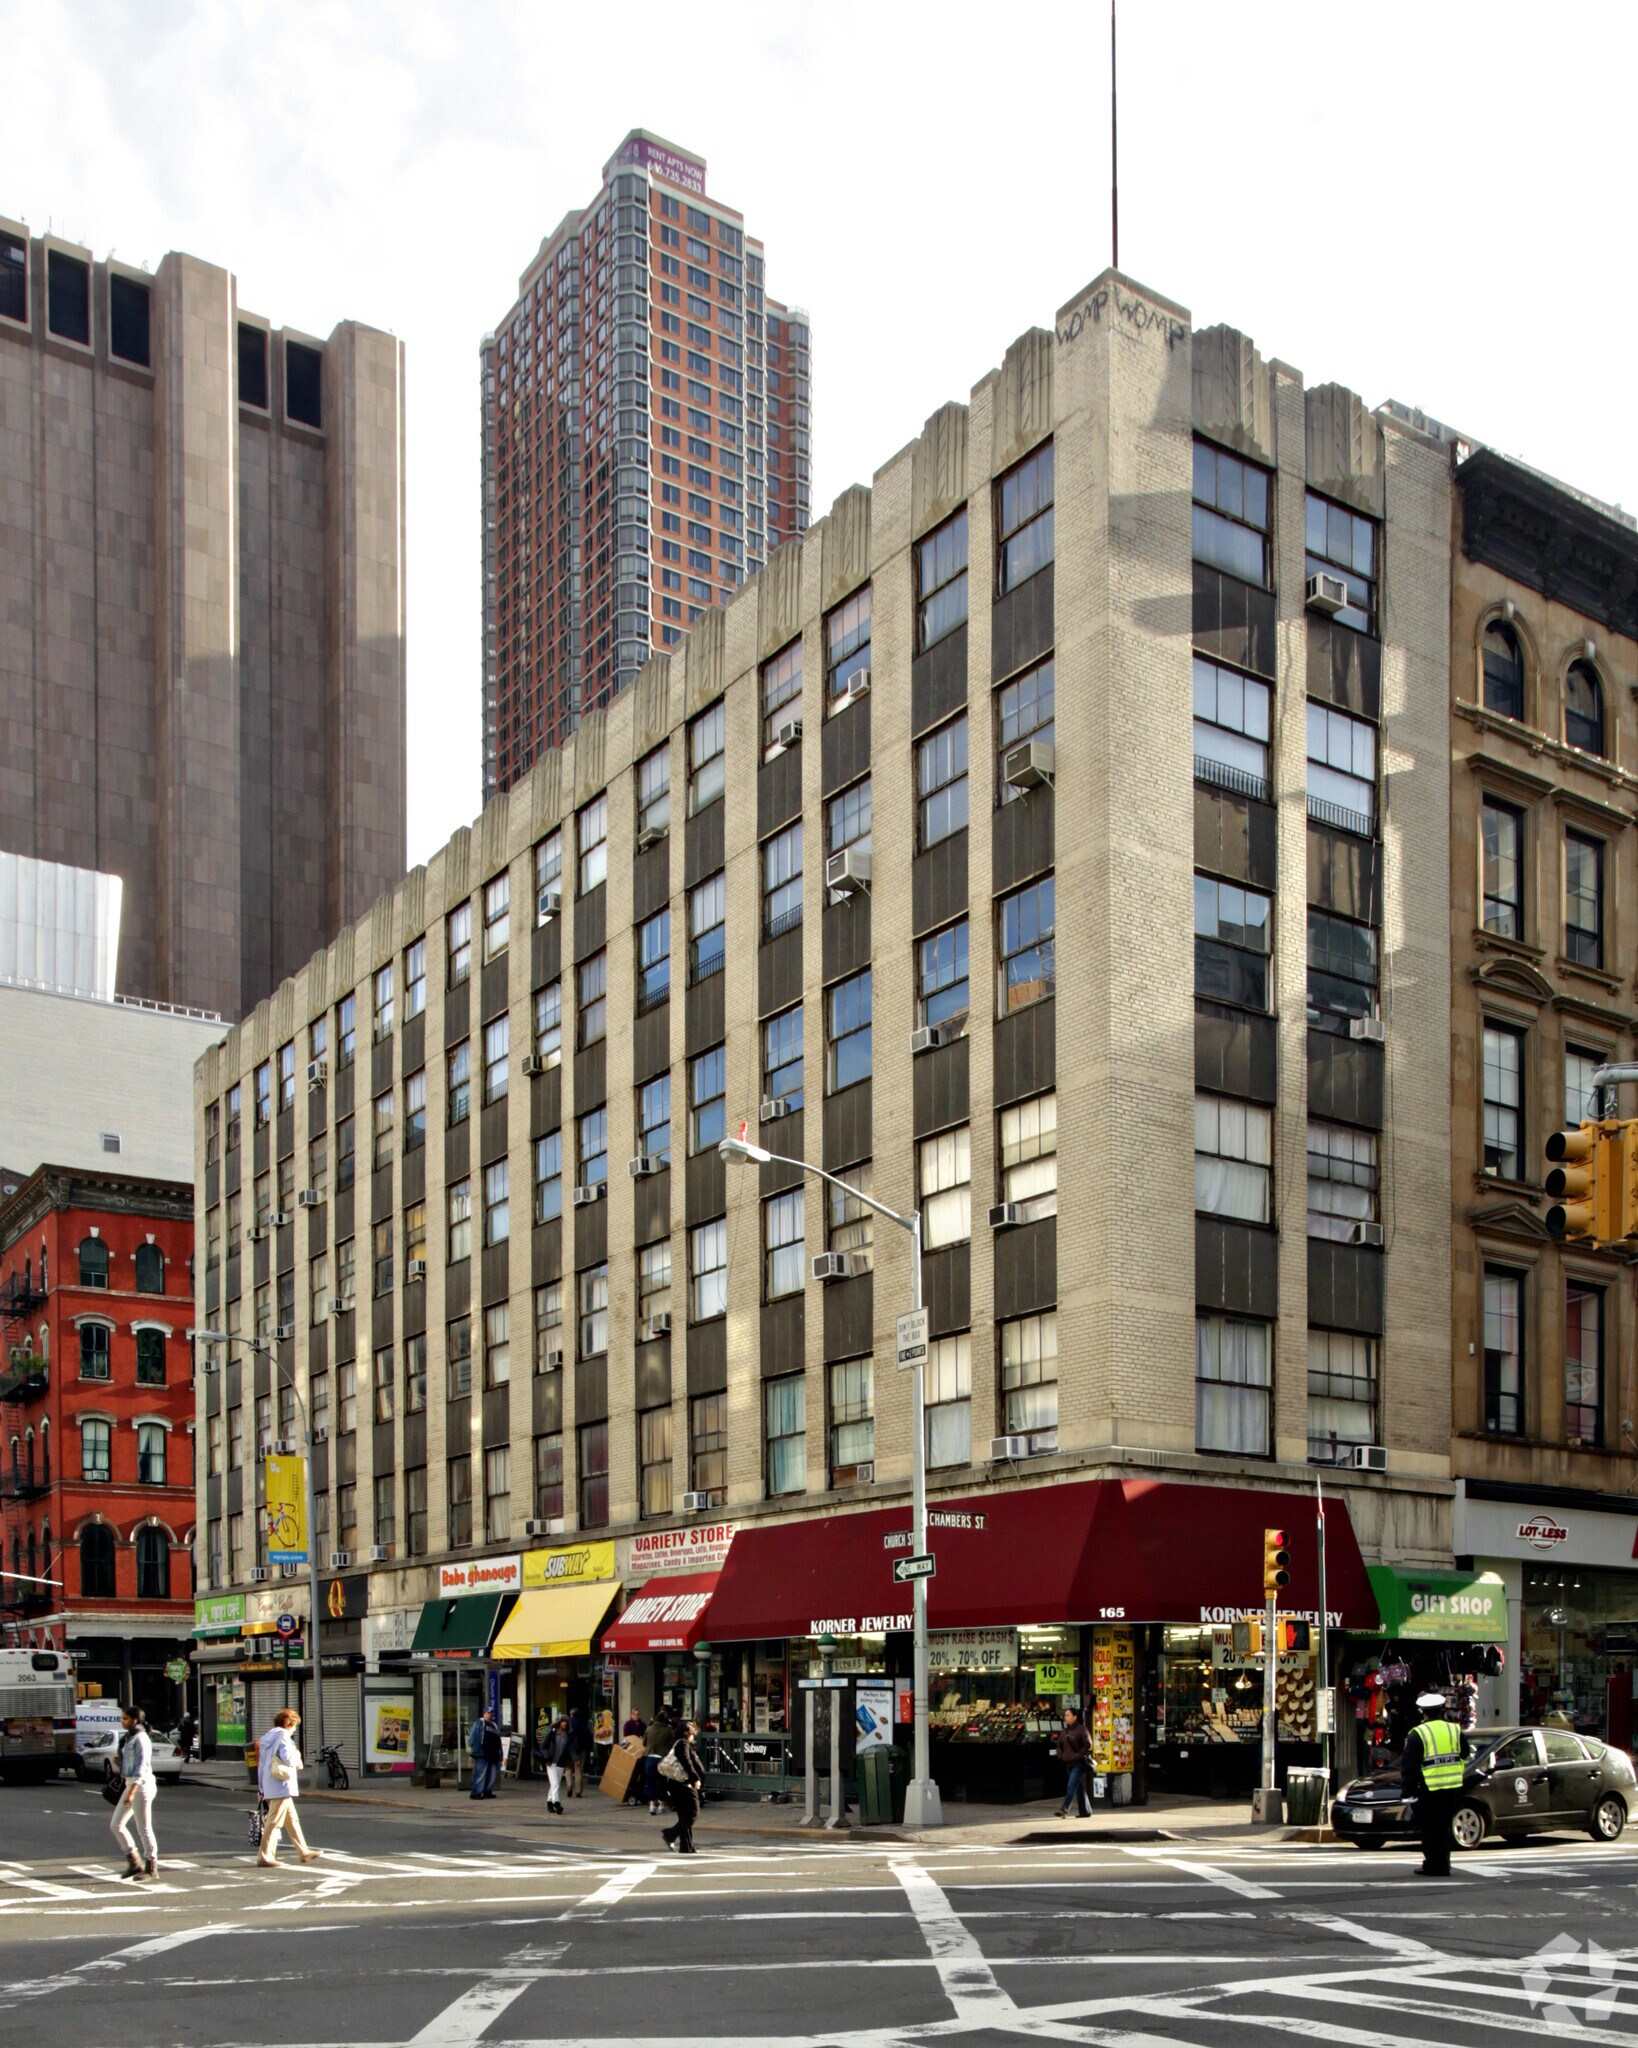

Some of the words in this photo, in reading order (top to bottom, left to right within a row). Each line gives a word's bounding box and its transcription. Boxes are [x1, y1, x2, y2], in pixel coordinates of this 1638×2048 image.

[648, 146, 666, 162] RENT
[667, 156, 684, 172] APTS
[685, 164, 702, 179] NOW
[929, 1512, 972, 1528] CHAMBERS
[974, 1516, 984, 1529] ST
[635, 1532, 686, 1552] VARIETY
[690, 1524, 733, 1544] STORE
[1518, 1525, 1567, 1540] LOT-LESS
[884, 1534, 906, 1548] CHURCH
[544, 1548, 591, 1581] SUBWAY
[664, 1558, 681, 1566] Candy
[688, 1554, 716, 1564] Imported
[900, 1564, 912, 1574] ONE
[916, 1561, 930, 1572] WAY
[442, 1568, 465, 1587] Baba
[468, 1564, 517, 1587] ghanouge
[618, 1596, 677, 1624] VARIETY
[662, 1592, 714, 1622] STORE
[1099, 1606, 1126, 1618] 165
[1411, 1594, 1446, 1614] GIFT
[1450, 1596, 1493, 1616] SHOP
[810, 1618, 856, 1634] KORNER
[860, 1614, 914, 1632] JEWELRY
[929, 1632, 949, 1645] MUST
[952, 1632, 976, 1645] RAISE
[1114, 1630, 1134, 1641] REPAIR
[1118, 1644, 1128, 1653] ON
[608, 1654, 631, 1666] ATM
[930, 1652, 950, 1666] 20%
[959, 1650, 978, 1665] 70%
[982, 1650, 1000, 1664] OFF
[1094, 1650, 1111, 1662] GOLD
[18, 1674, 36, 1682] 2063
[744, 1742, 767, 1756] Subway
[1434, 1756, 1456, 1765] NYPD
